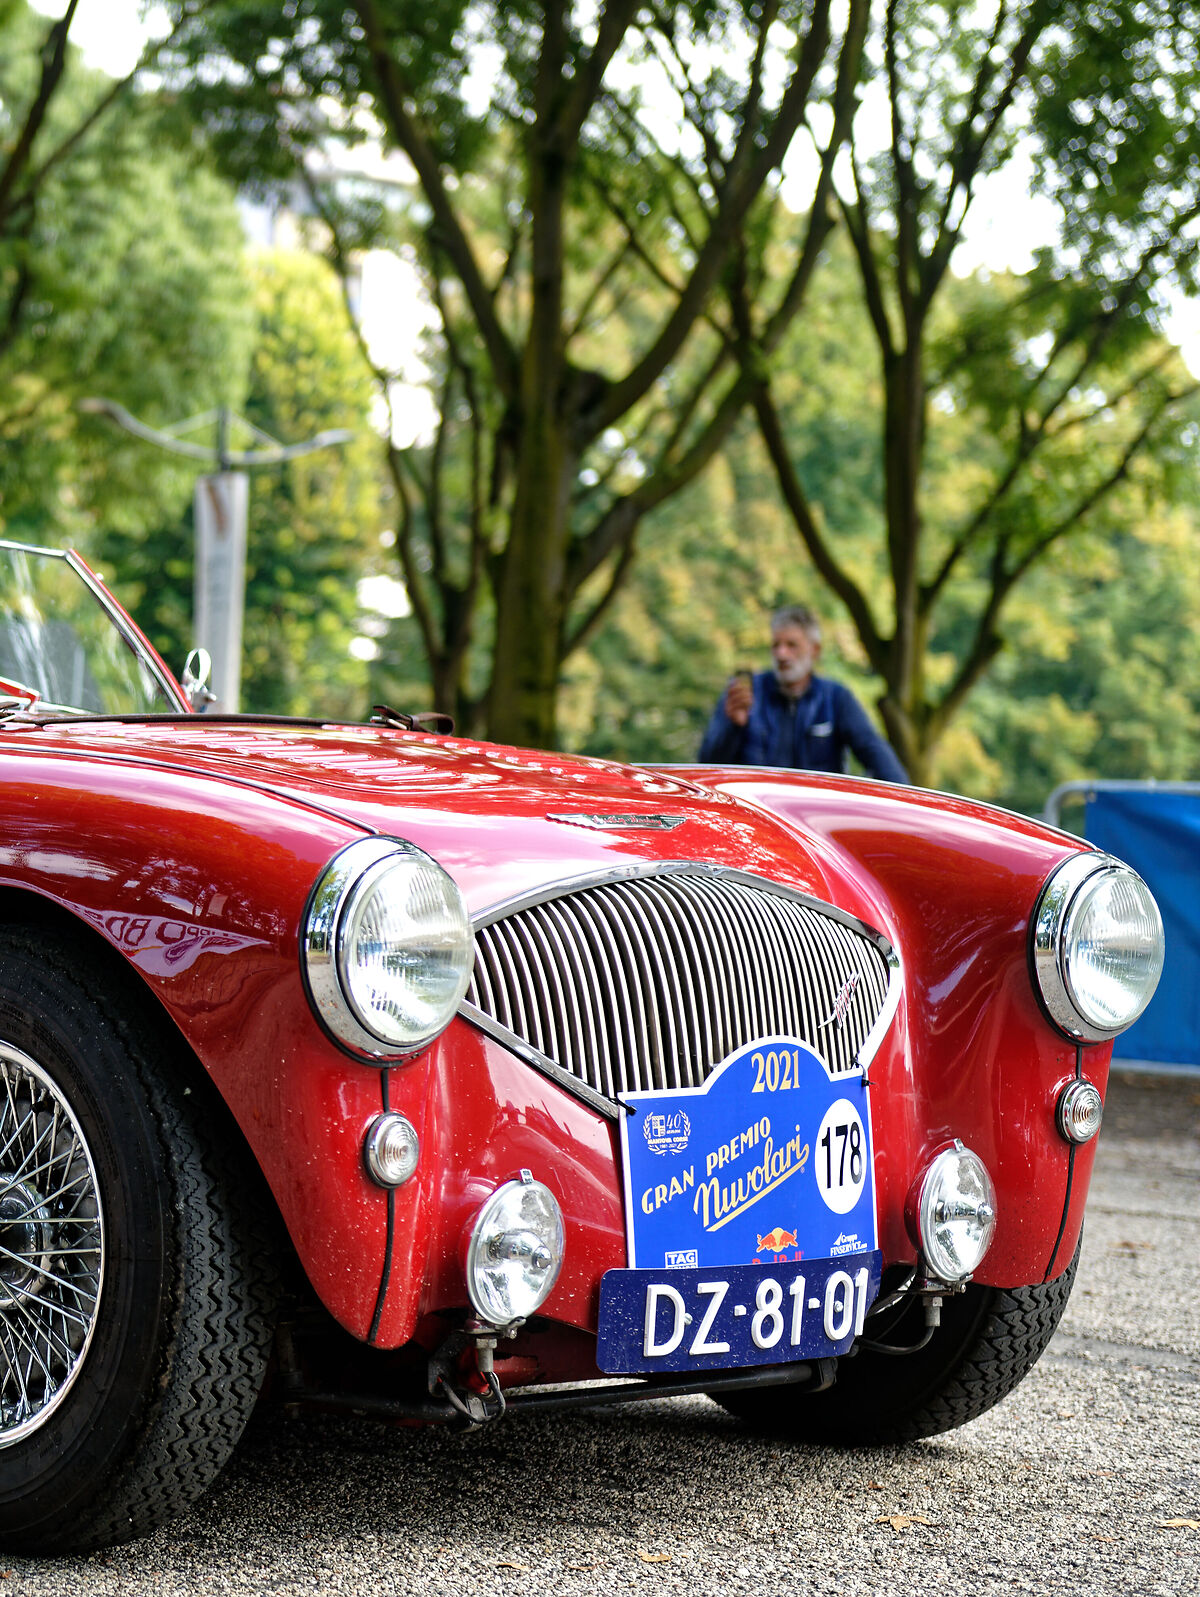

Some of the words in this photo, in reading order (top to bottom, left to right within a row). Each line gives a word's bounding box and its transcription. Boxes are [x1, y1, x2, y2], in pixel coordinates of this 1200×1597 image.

[751, 1049, 801, 1093] 2021
[647, 1137, 673, 1145] MANTOVA
[666, 1113, 682, 1129] 40
[641, 1165, 695, 1215] GRAN
[706, 1116, 771, 1177] PREMIO
[693, 1124, 810, 1230] Nuvolari
[821, 1121, 863, 1189] 178
[668, 1253, 696, 1265] TAG
[643, 1267, 869, 1357] DZ-81-01
